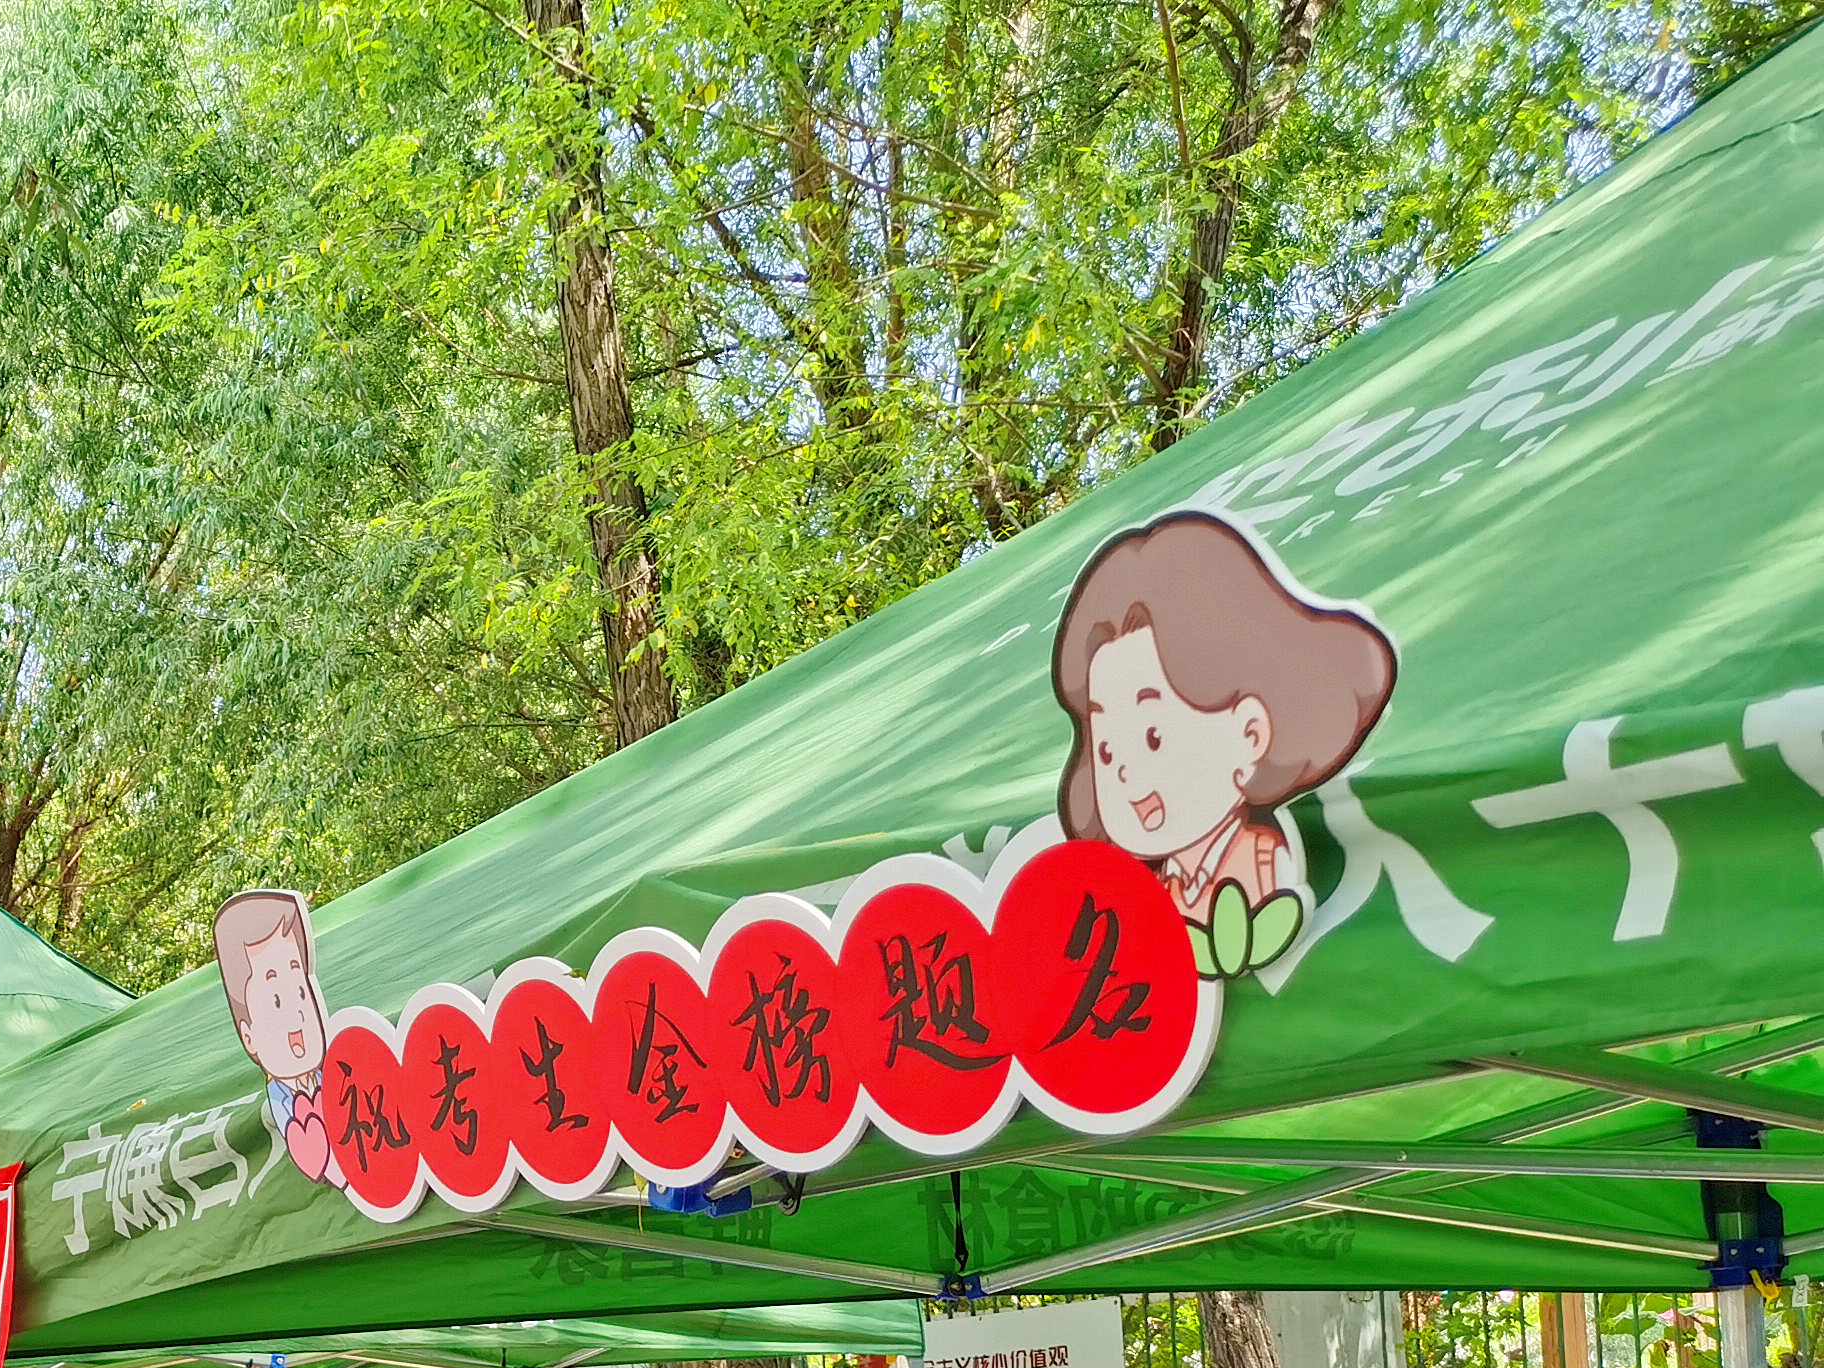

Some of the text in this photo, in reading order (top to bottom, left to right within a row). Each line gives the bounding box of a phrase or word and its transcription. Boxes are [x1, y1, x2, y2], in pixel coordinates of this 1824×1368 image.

[1258, 424, 1564, 546] RESH
[337, 892, 1151, 1172] 祝考生金榜题名
